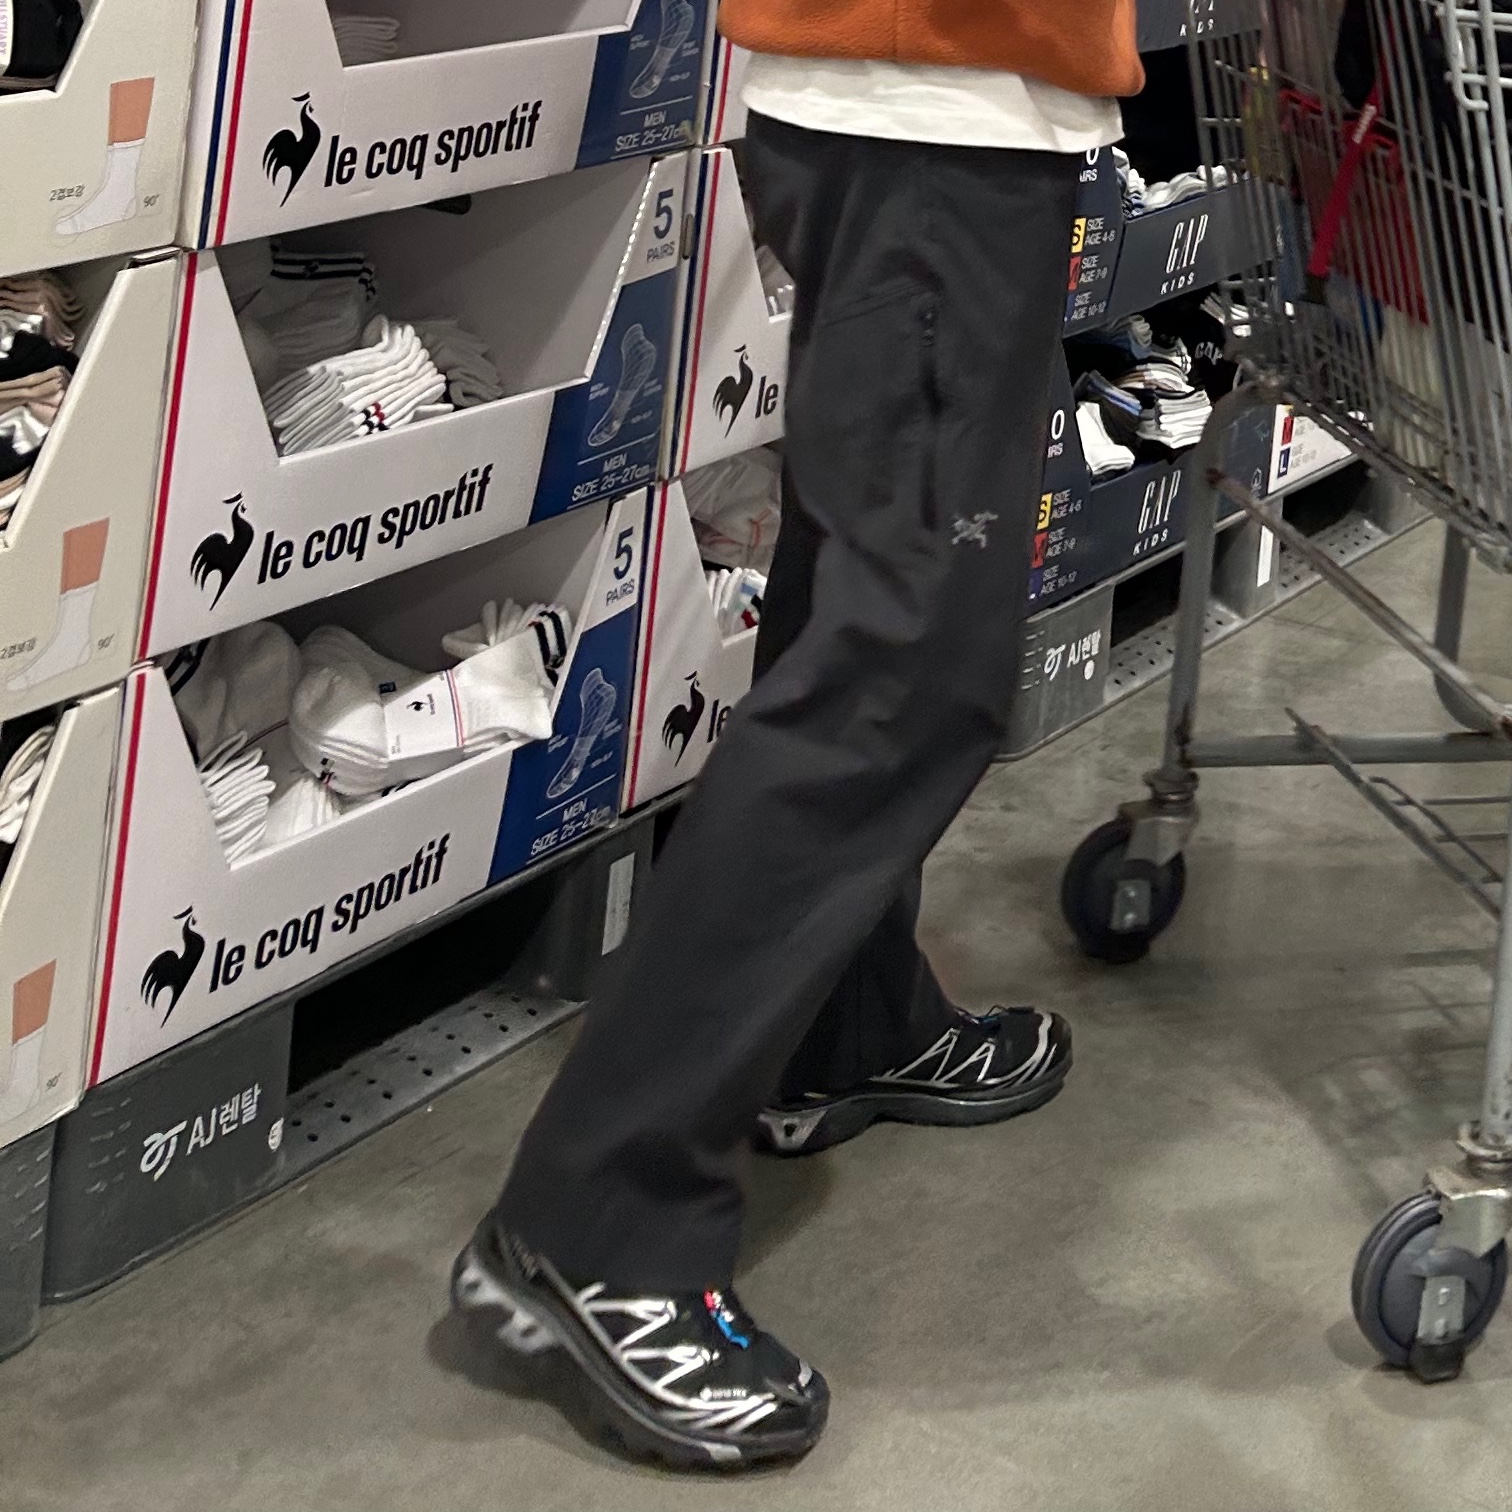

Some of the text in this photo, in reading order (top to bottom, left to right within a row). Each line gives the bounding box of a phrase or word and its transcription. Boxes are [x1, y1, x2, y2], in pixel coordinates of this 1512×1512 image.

[644, 110, 667, 128] MEN
[324, 100, 543, 187] le coq sportif
[615, 131, 640, 152] SIZE
[653, 189, 673, 240] 5
[646, 240, 677, 264] PAIRS
[1165, 214, 1209, 274] GAP
[1160, 272, 1195, 295] KIDS
[755, 376, 778, 418] le
[1051, 409, 1065, 440] 0
[602, 453, 628, 473] MEN
[572, 478, 600, 501] SIZE
[1138, 469, 1182, 534] GAP
[257, 463, 494, 585] le coq sportif
[1039, 499, 1047, 523] S
[612, 526, 635, 580] 5
[1133, 528, 1168, 556] KIDS
[562, 798, 588, 822] MEN
[531, 828, 559, 856] SIZE
[209, 833, 450, 992] le coq sportif
[186, 1082, 262, 1156] AJ렌탈
